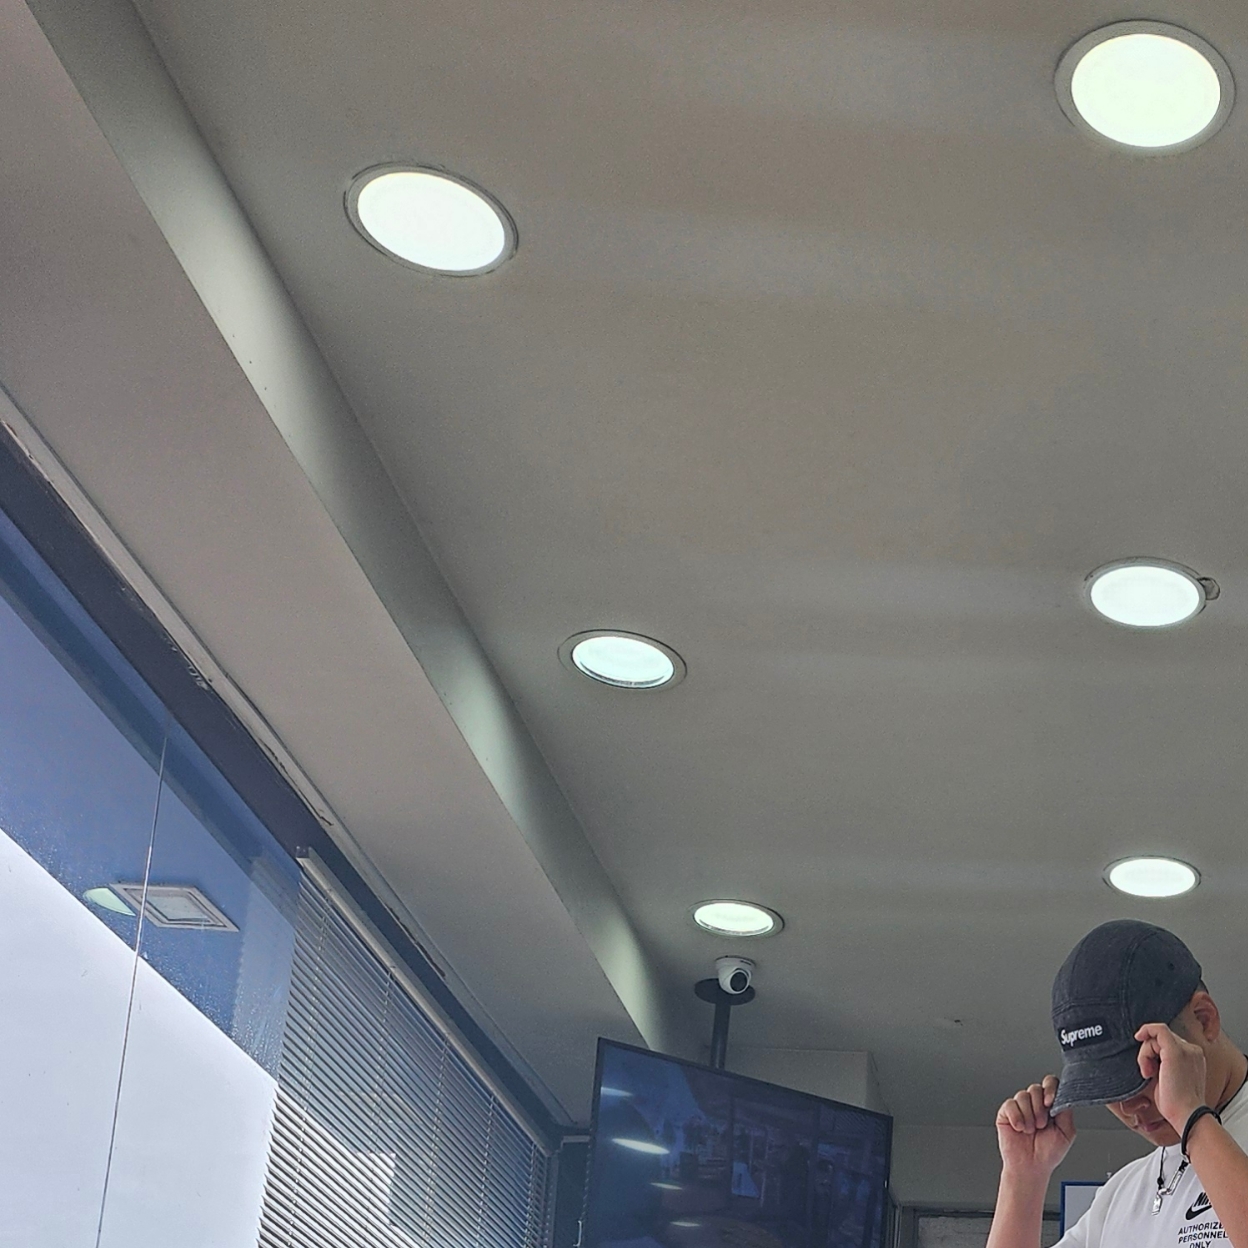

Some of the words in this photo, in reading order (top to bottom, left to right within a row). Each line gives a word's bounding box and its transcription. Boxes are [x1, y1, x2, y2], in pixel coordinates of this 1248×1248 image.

[1060, 1023, 1104, 1047] Supreme
[1177, 1221, 1225, 1236] AUTHORIZE
[1178, 1230, 1229, 1244] PERSONNEL
